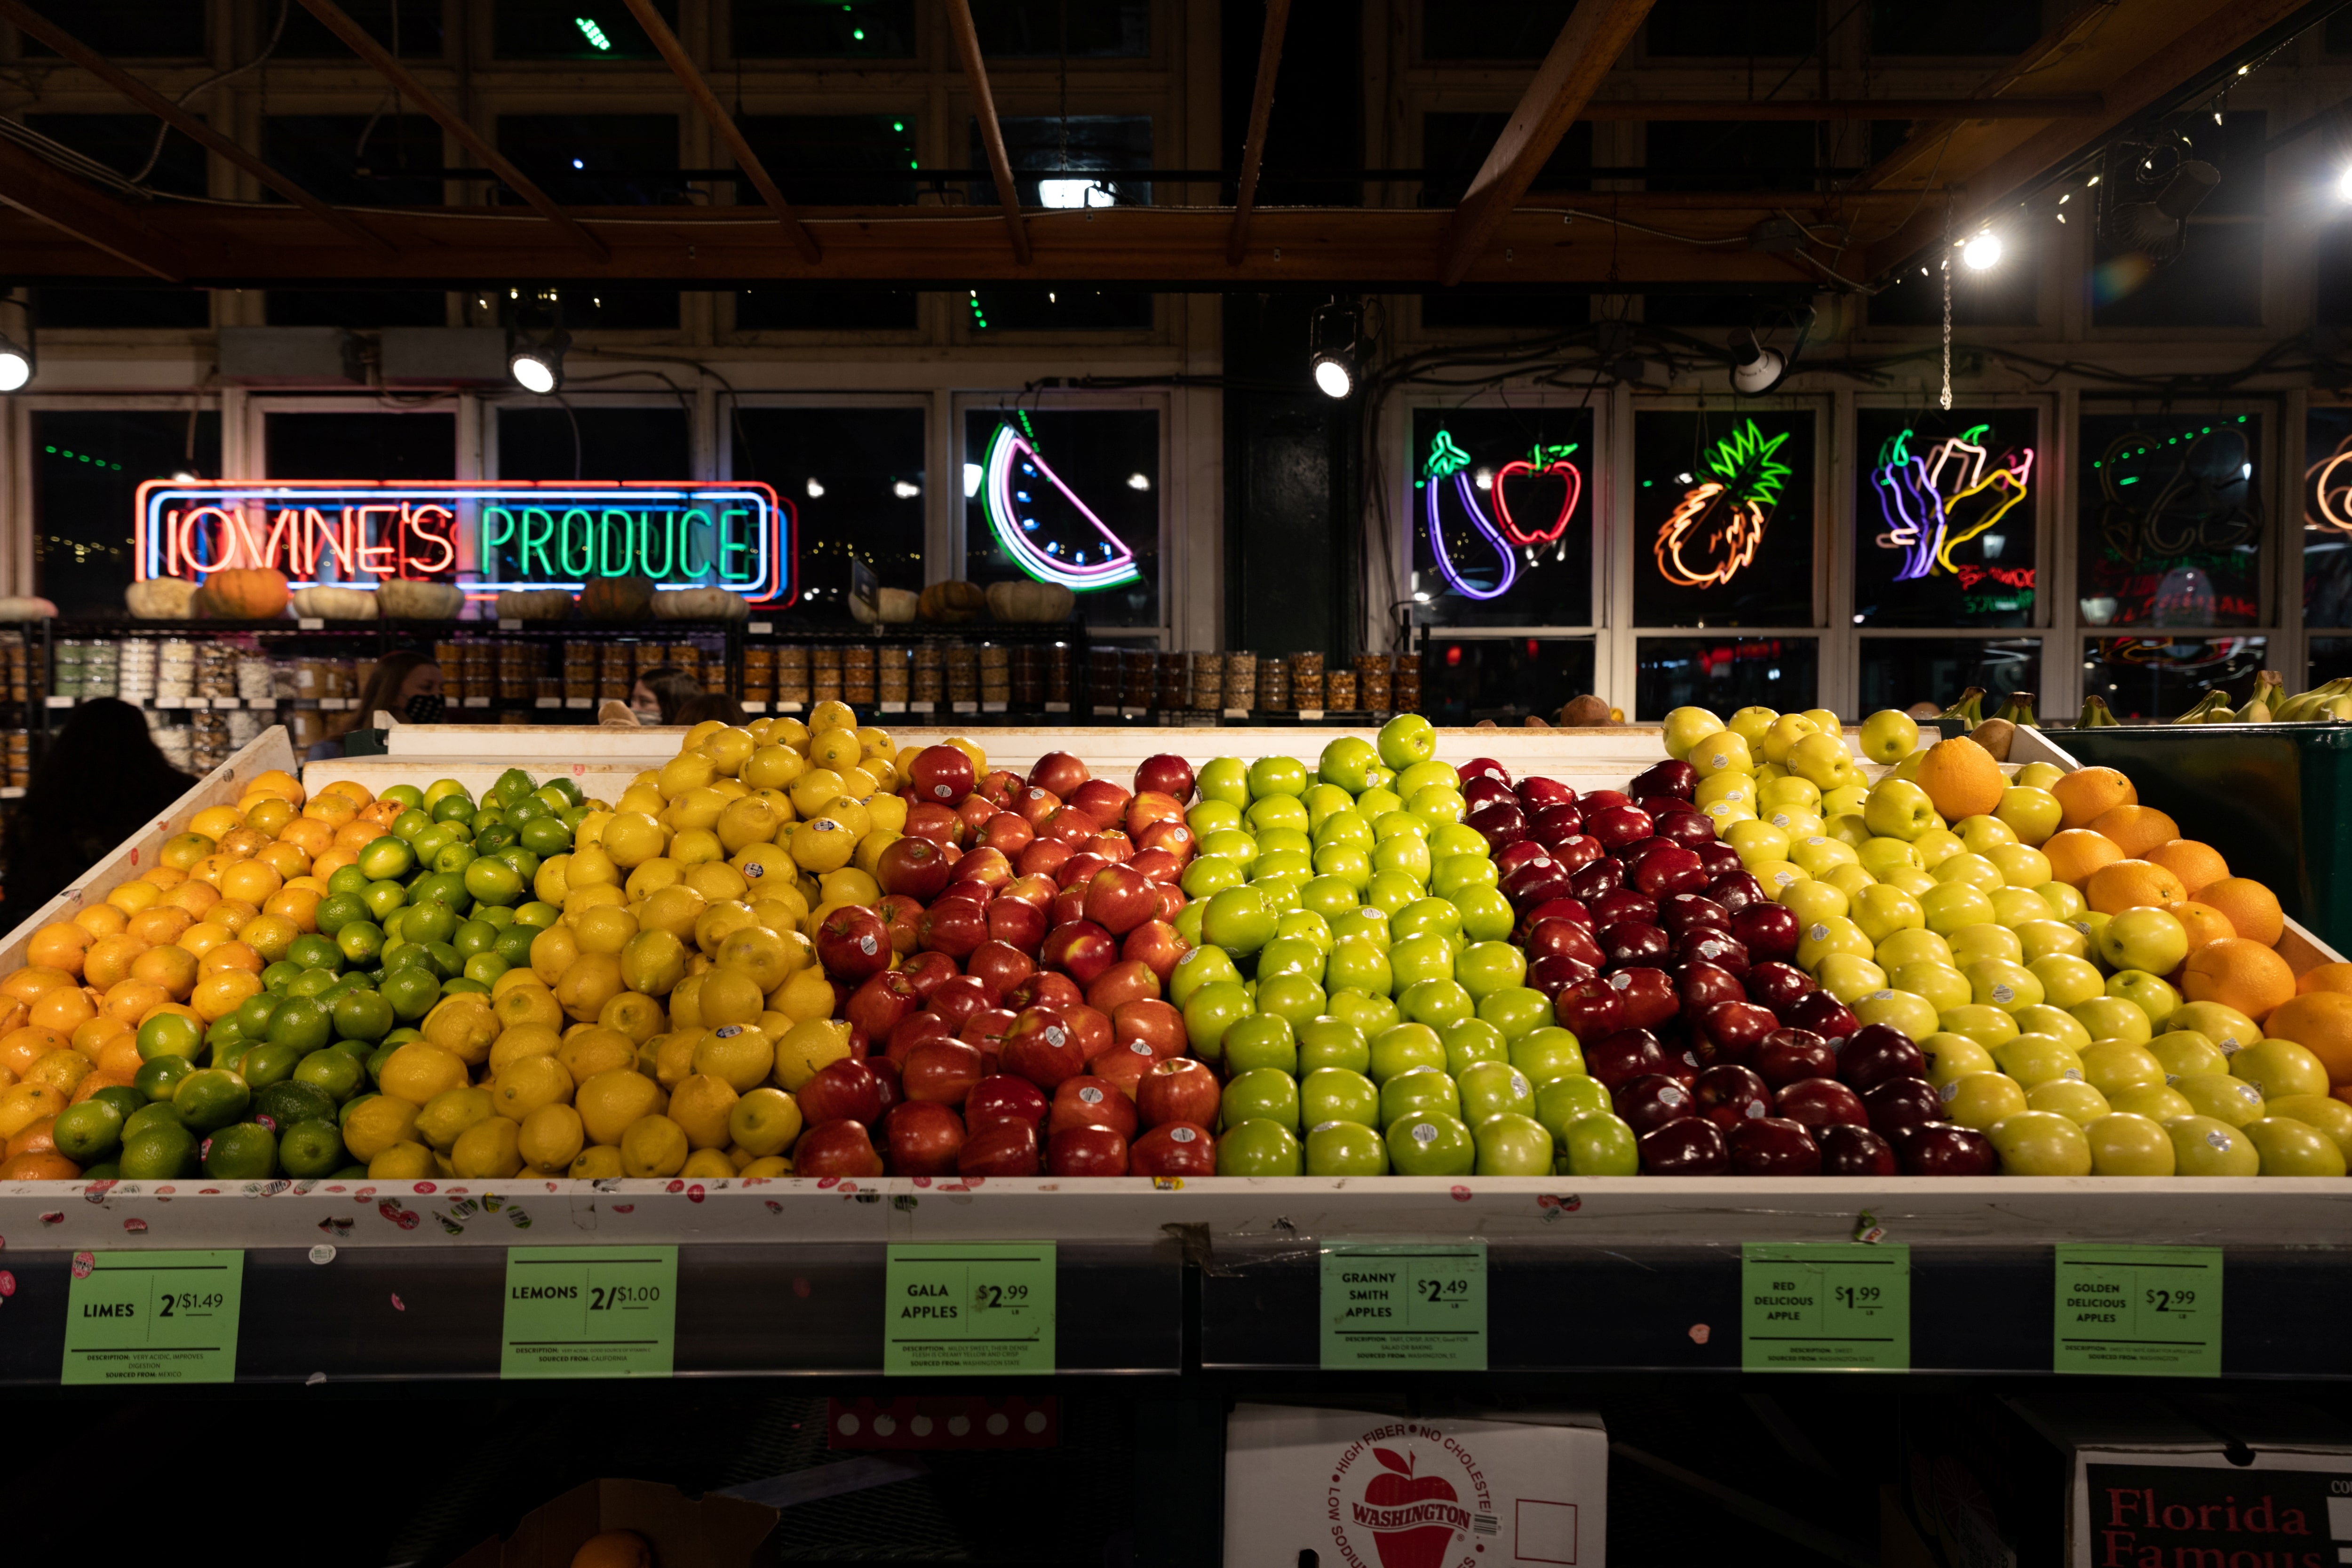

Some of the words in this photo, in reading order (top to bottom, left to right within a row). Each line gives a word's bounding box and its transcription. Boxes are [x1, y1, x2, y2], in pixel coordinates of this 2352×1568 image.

[166, 501, 454, 577] IOVINE'S
[482, 506, 751, 580] PRODUCE
[1342, 1273, 1396, 1283] GRANNY
[1773, 1282, 1795, 1290] RED
[512, 1286, 578, 1299] LEMONS
[907, 1284, 949, 1297] GALA
[978, 1285, 1028, 1308] $2.99
[1350, 1290, 1388, 1300] SMITH
[1418, 1280, 1467, 1302] $2.49
[1836, 1286, 1880, 1308] $1.99
[2074, 1283, 2120, 1293] GOLDEN
[159, 1293, 223, 1317] 2/$1.49
[590, 1286, 660, 1310] 2/$1.00
[1755, 1297, 1813, 1305] DELICIOUS
[2067, 1298, 2126, 1308] DELICIOUS
[2146, 1289, 2195, 1312] $2.99
[84, 1304, 135, 1317] LIMES
[901, 1306, 958, 1318] APPLES
[1346, 1307, 1392, 1317] APPLES
[1767, 1312, 1801, 1321] APPLE
[2076, 1314, 2116, 1322] APPLES
[1336, 1441, 1364, 1474] HIGH
[1363, 1424, 1406, 1446] FIBER
[1420, 1426, 1442, 1442] NO
[1444, 1438, 1491, 1513] CHOLESTE
[2331, 1480, 2352, 1494] CO
[1328, 1487, 1341, 1521] LOW
[2105, 1488, 2312, 1536] Florida
[1352, 1502, 1472, 1529] WASHINGTON
[1332, 1525, 1367, 1568] SODIU
[2100, 1529, 2323, 1568] Famous
